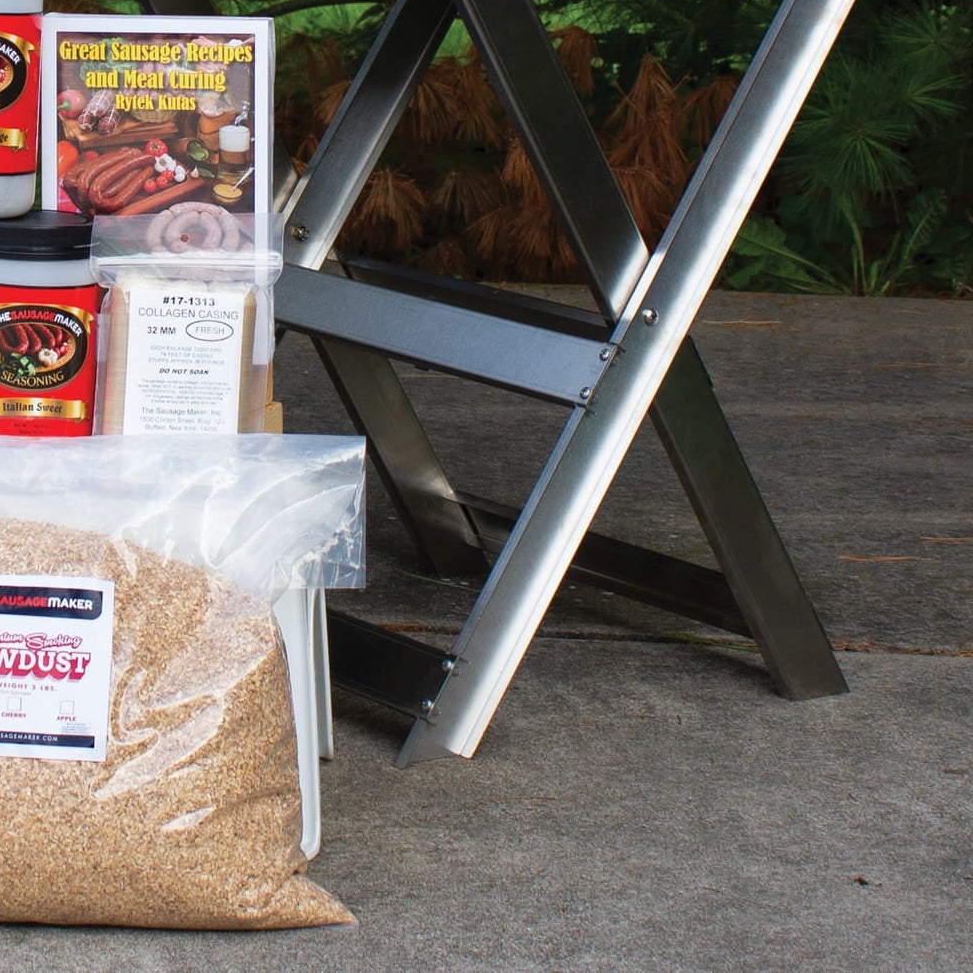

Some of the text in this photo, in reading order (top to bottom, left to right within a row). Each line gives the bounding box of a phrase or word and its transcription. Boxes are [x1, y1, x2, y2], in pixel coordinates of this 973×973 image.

[59, 41, 253, 64] Great Sausage Recipes
[85, 70, 226, 92] and Meat Curing
[115, 94, 196, 111] Rytek Kutas
[163, 296, 215, 307] #17-1313
[138, 307, 239, 320] COLLAGEN CASING
[147, 326, 176, 335] 32 MM
[195, 326, 225, 335] FRESH
[0, 370, 64, 388] SEASONING
[2, 401, 63, 414] Italian Sweet
[155, 407, 185, 416] Sausage
[25, 632, 83, 650] Smoking
[1, 711, 27, 719] CHERRY
